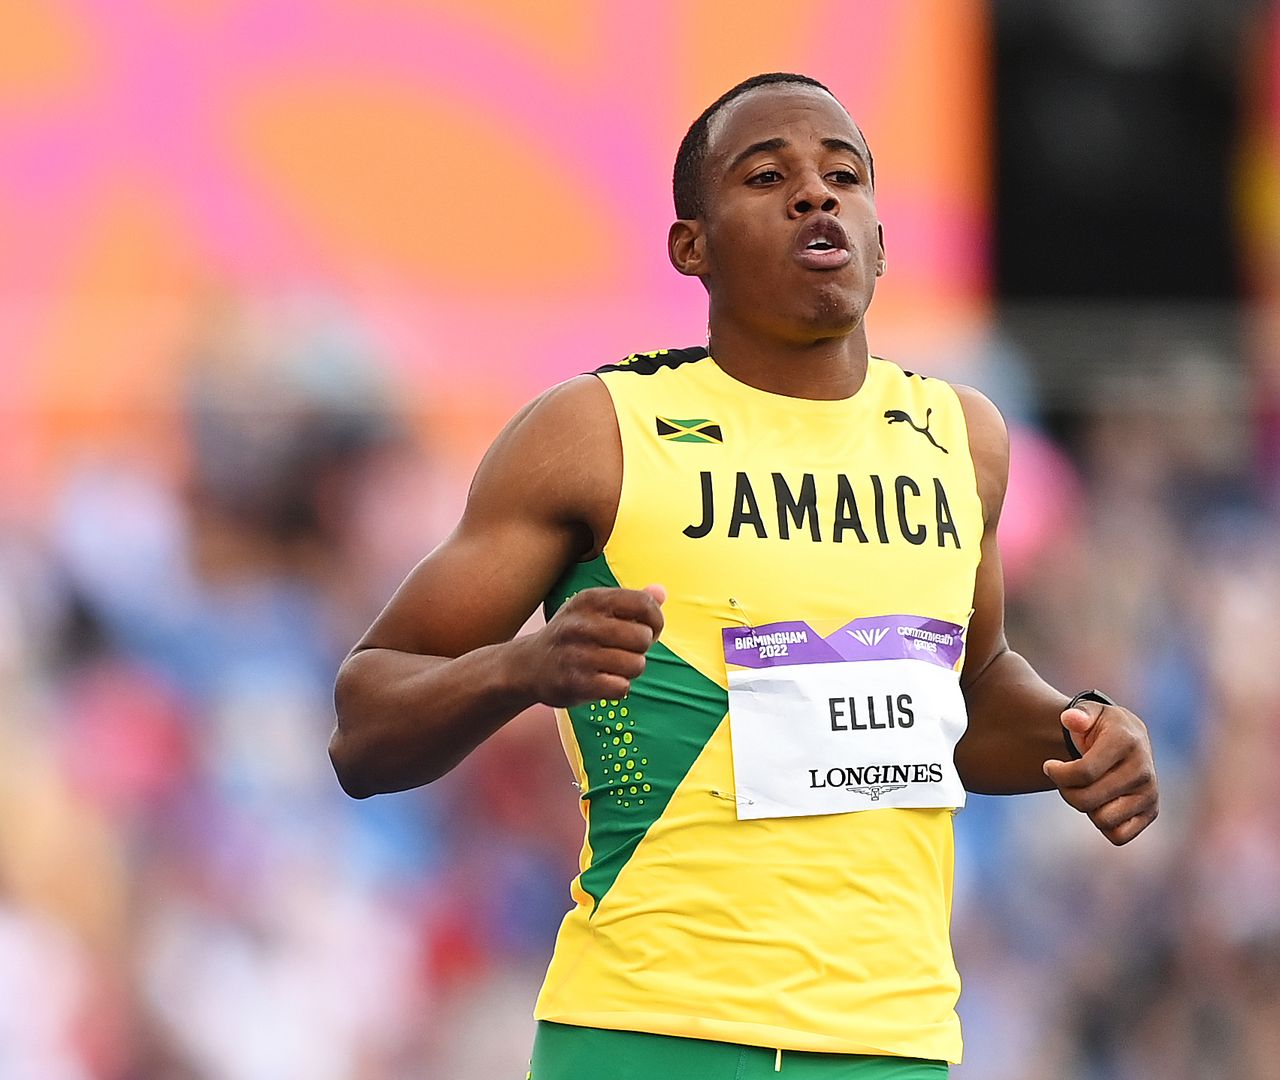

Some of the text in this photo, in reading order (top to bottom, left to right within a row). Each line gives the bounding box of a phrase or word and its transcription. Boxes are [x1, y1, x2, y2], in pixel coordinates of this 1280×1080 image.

[682, 471, 962, 550] JAMAICA
[735, 631, 808, 650] BIRMINGHAM
[759, 645, 789, 659] 2022
[828, 693, 915, 731] ELLIS
[808, 763, 943, 788] LONGINES
